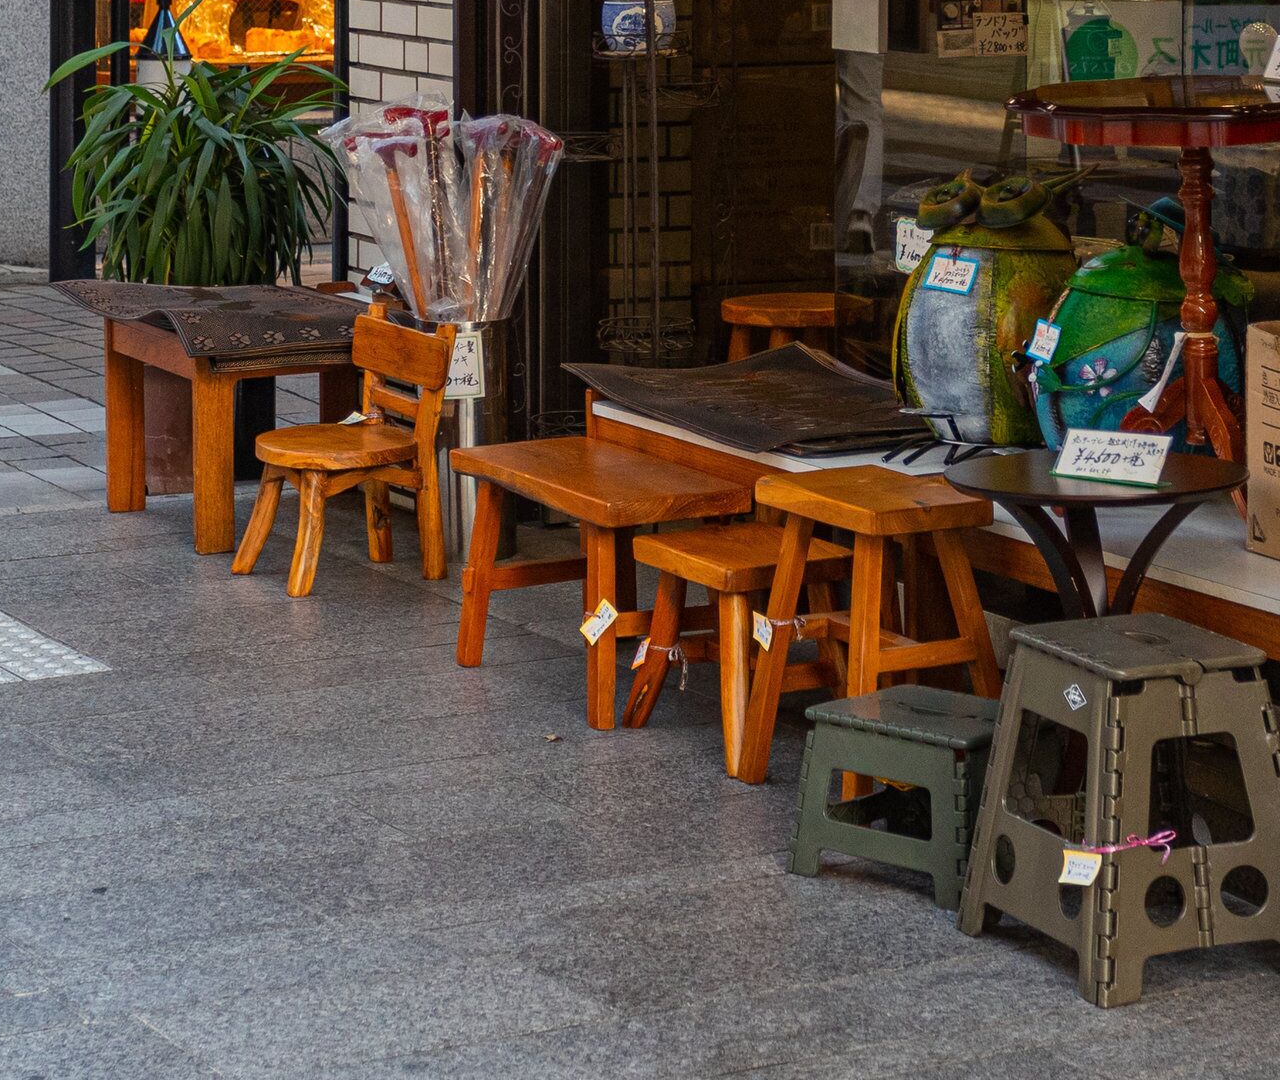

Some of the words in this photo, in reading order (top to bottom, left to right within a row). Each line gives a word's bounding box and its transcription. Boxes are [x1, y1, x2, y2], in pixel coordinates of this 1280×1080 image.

[975, 14, 1024, 28] ランドリー
[991, 26, 1024, 40] バッグ
[1264, 467, 1277, 477] MADE
